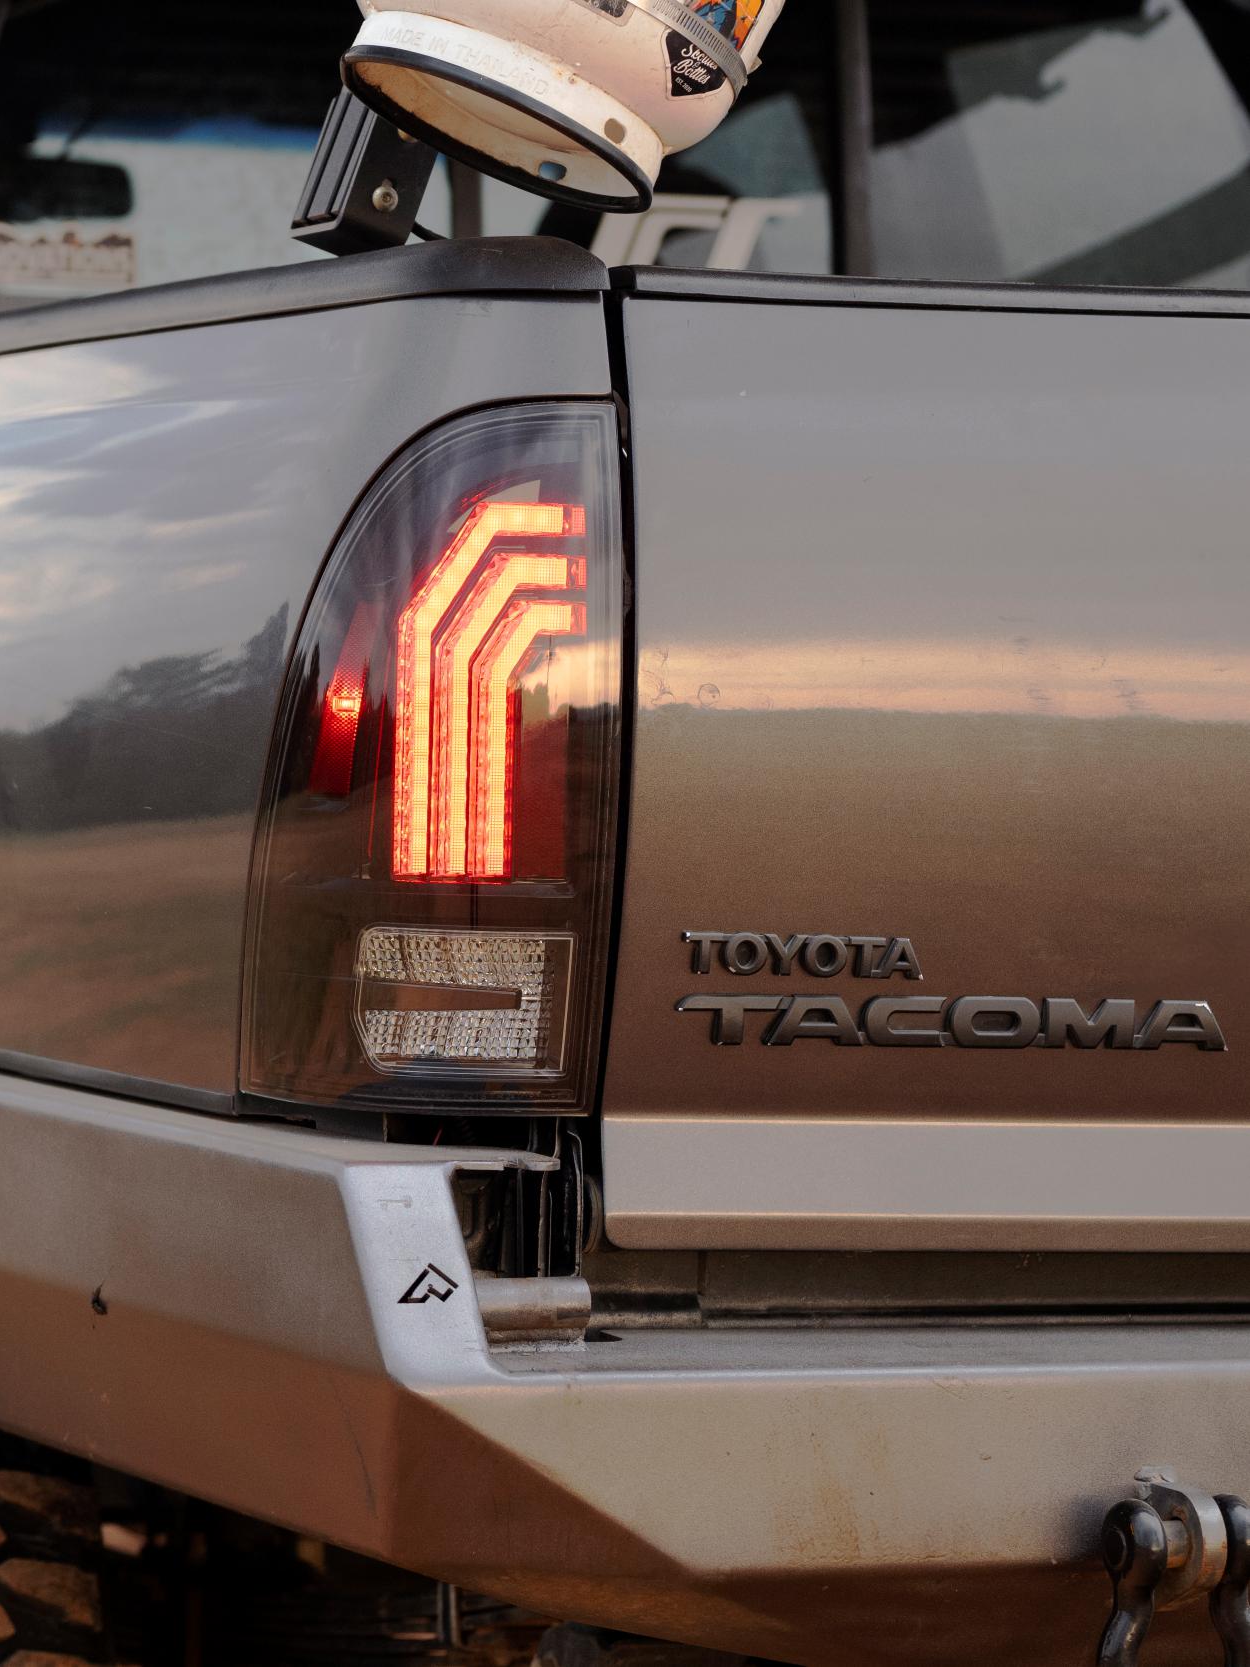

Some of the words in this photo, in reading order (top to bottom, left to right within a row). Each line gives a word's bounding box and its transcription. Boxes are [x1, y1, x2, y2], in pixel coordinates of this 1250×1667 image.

[380, 25, 425, 45] MADE
[427, 35, 449, 54] IN
[673, 58, 711, 85] Bottles
[682, 930, 925, 981] TOYOTA
[674, 992, 1228, 1051] TACOMA
